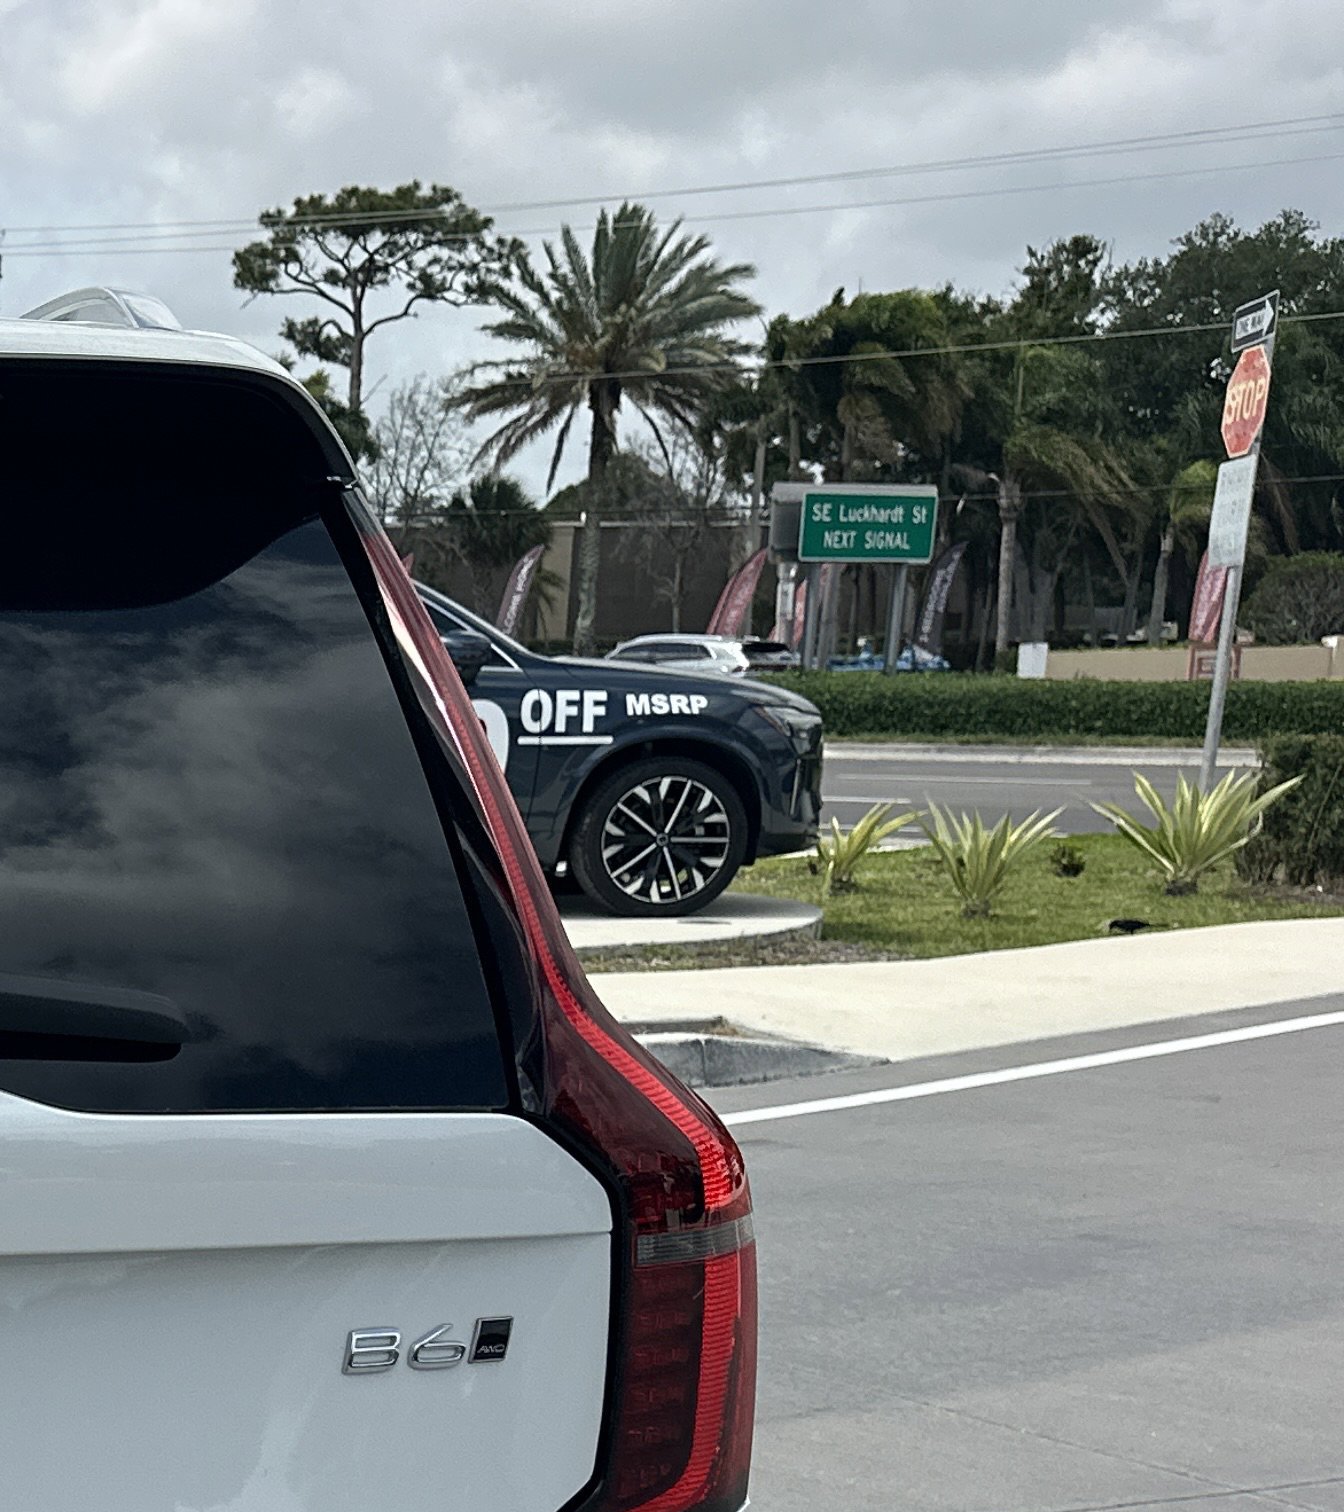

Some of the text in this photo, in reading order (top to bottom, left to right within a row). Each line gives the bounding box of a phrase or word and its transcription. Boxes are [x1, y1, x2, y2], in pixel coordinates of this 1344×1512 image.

[1226, 377, 1266, 425] STOP
[812, 503, 928, 524] SE Luckhardt St
[823, 531, 911, 551] NEXT SIGNAL
[520, 688, 708, 734] OFF MSRP
[342, 1323, 467, 1376] B6
